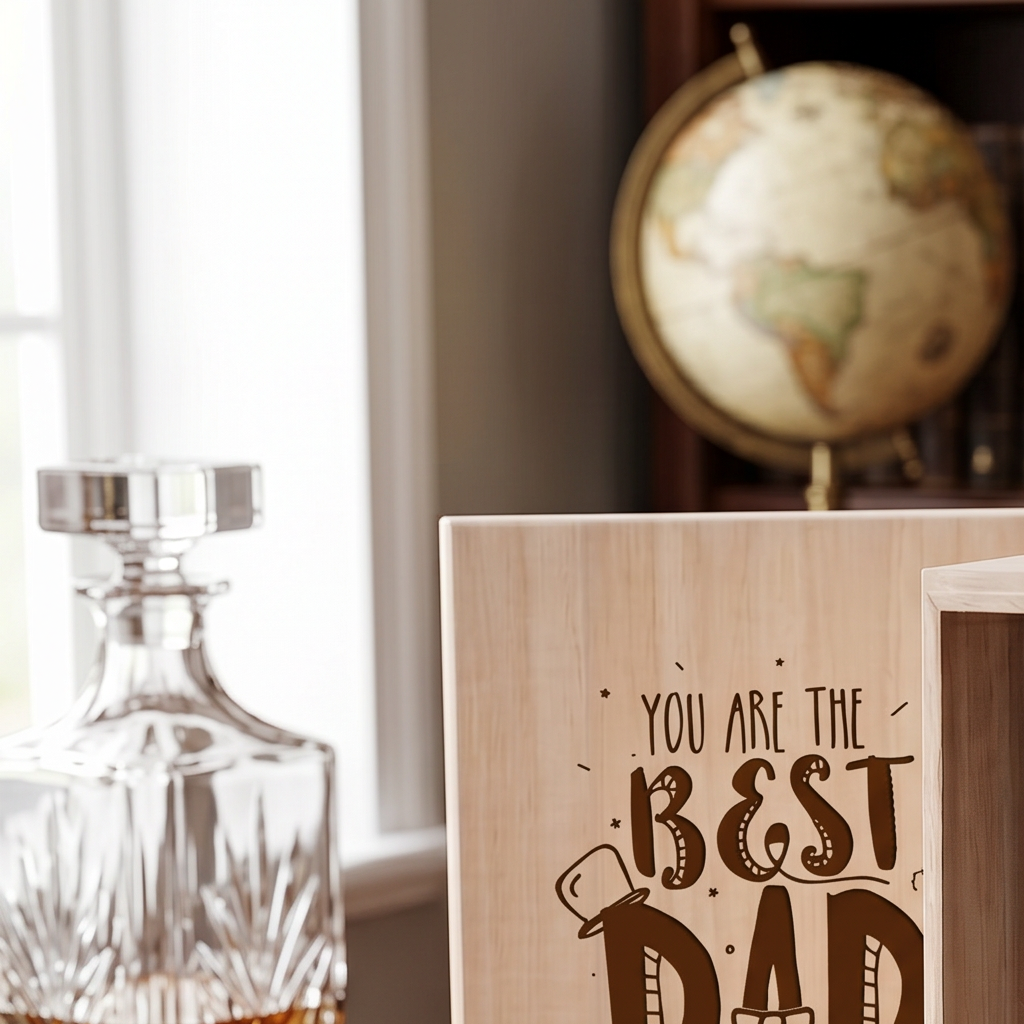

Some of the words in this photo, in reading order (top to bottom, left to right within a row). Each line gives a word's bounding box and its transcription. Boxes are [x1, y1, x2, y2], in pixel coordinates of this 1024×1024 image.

[641, 692, 705, 756] YOU
[725, 689, 786, 754] ARE
[804, 686, 865, 750] THE
[630, 754, 915, 889] BEST
